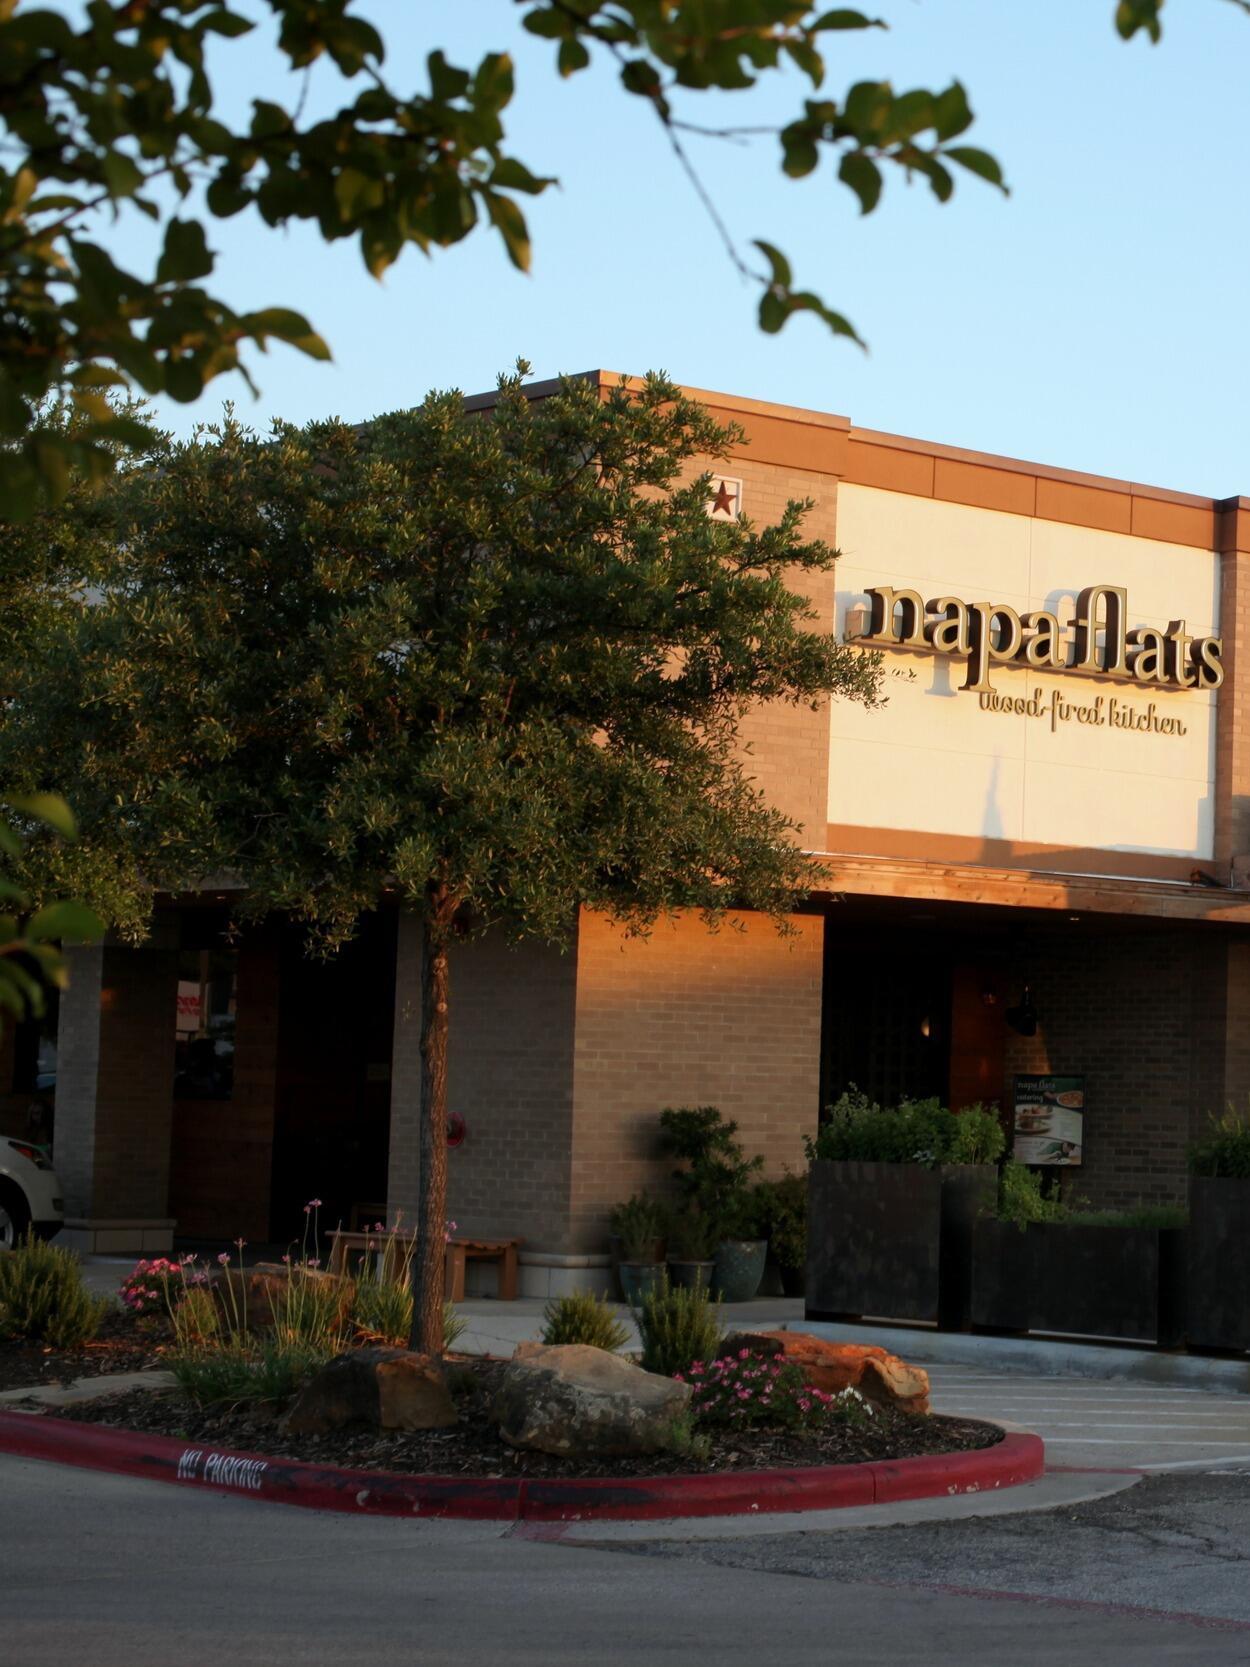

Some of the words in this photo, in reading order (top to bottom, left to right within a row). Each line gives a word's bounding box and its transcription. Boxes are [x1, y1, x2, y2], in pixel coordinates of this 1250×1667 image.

[979, 687, 1105, 733] wood-fired
[1108, 697, 1187, 737] kitchen
[177, 1448, 203, 1479] NO
[203, 1452, 269, 1490] PARKING
